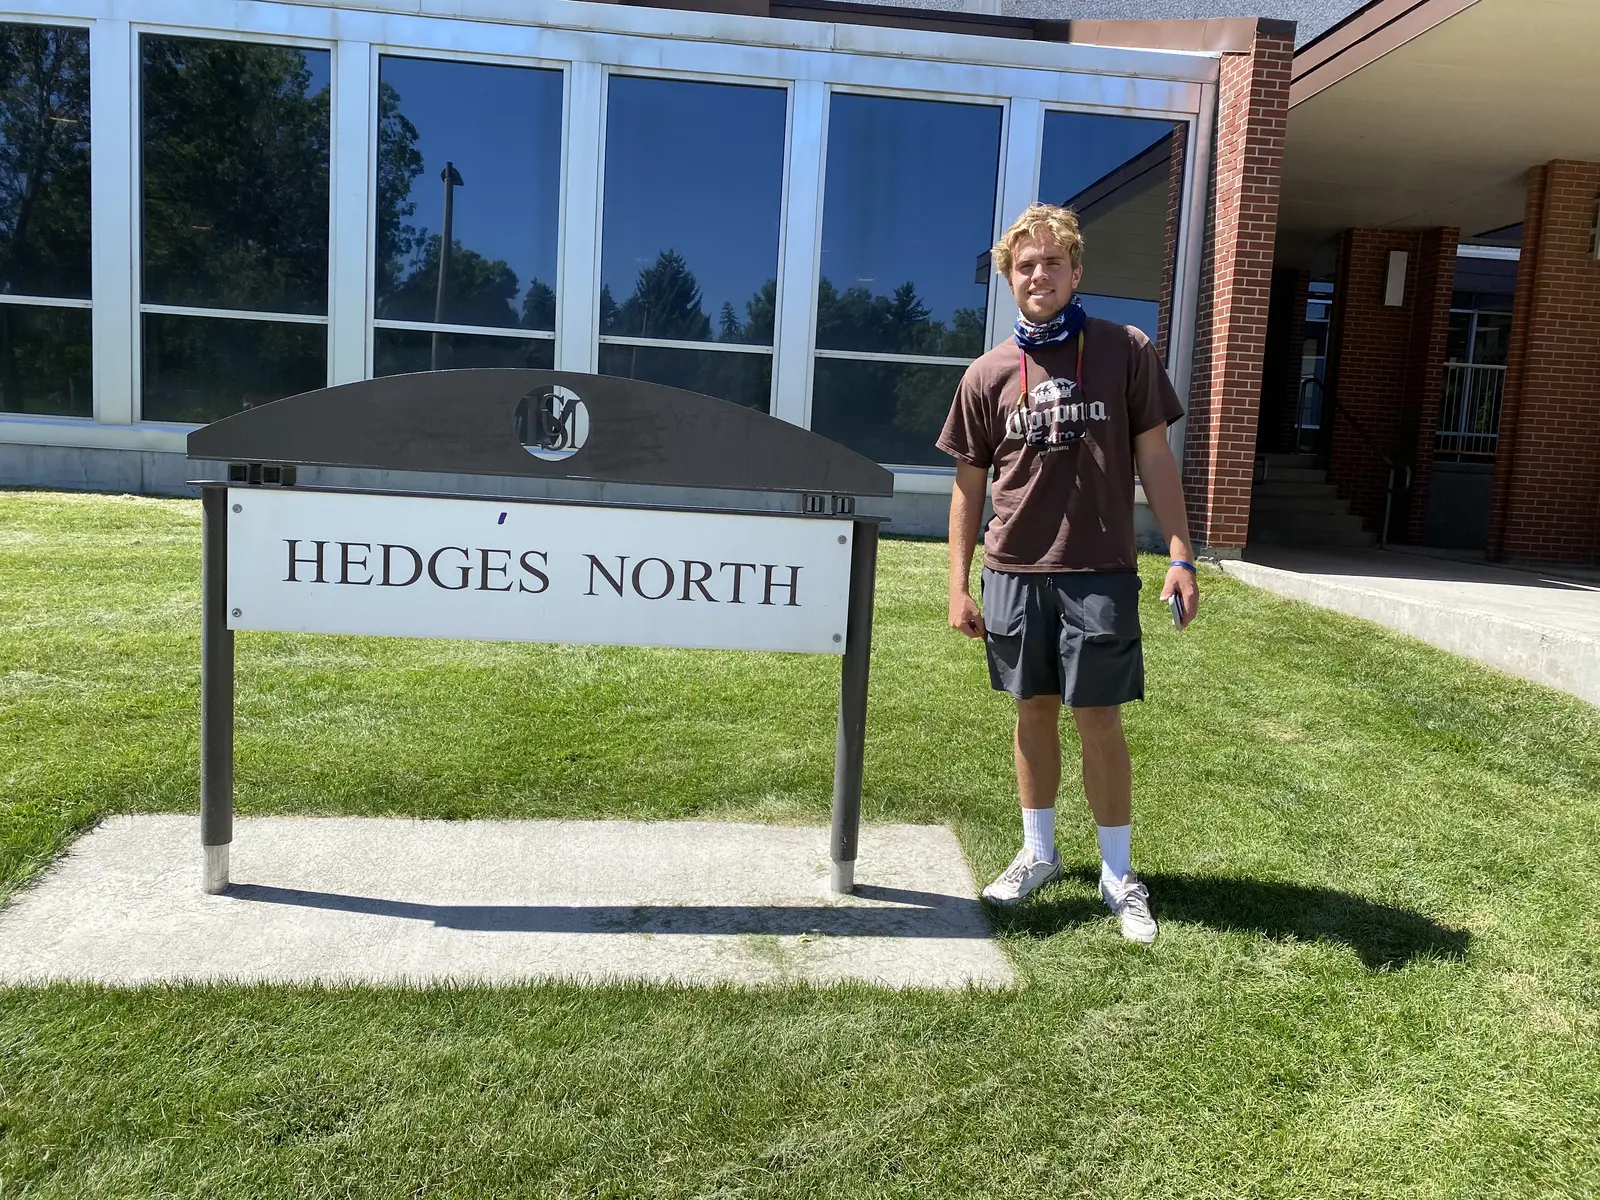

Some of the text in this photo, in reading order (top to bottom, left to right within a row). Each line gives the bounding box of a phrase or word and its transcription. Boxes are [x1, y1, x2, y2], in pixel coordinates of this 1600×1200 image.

[1005, 400, 1107, 440] Corona
[282, 538, 804, 607] HEDGES NORTH
